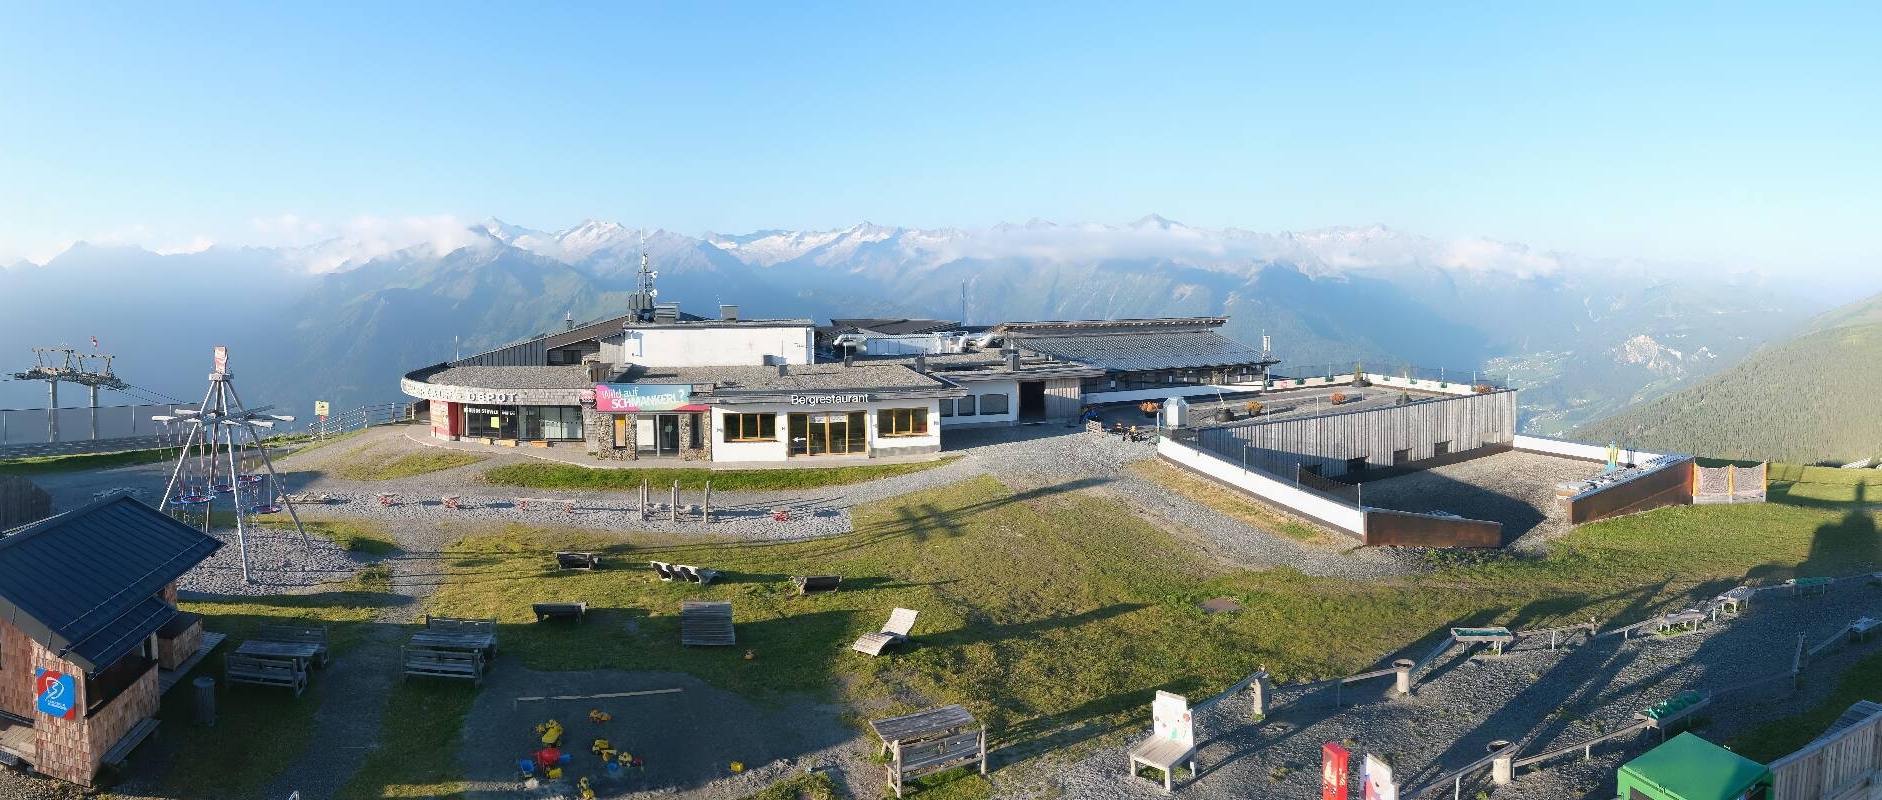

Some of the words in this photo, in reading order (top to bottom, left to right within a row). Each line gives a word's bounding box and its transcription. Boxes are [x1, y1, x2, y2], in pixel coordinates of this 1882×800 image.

[468, 393, 517, 402] DEPOT
[601, 389, 622, 399] Wild
[623, 387, 639, 398] auf
[791, 394, 869, 406] Bergrestaurant
